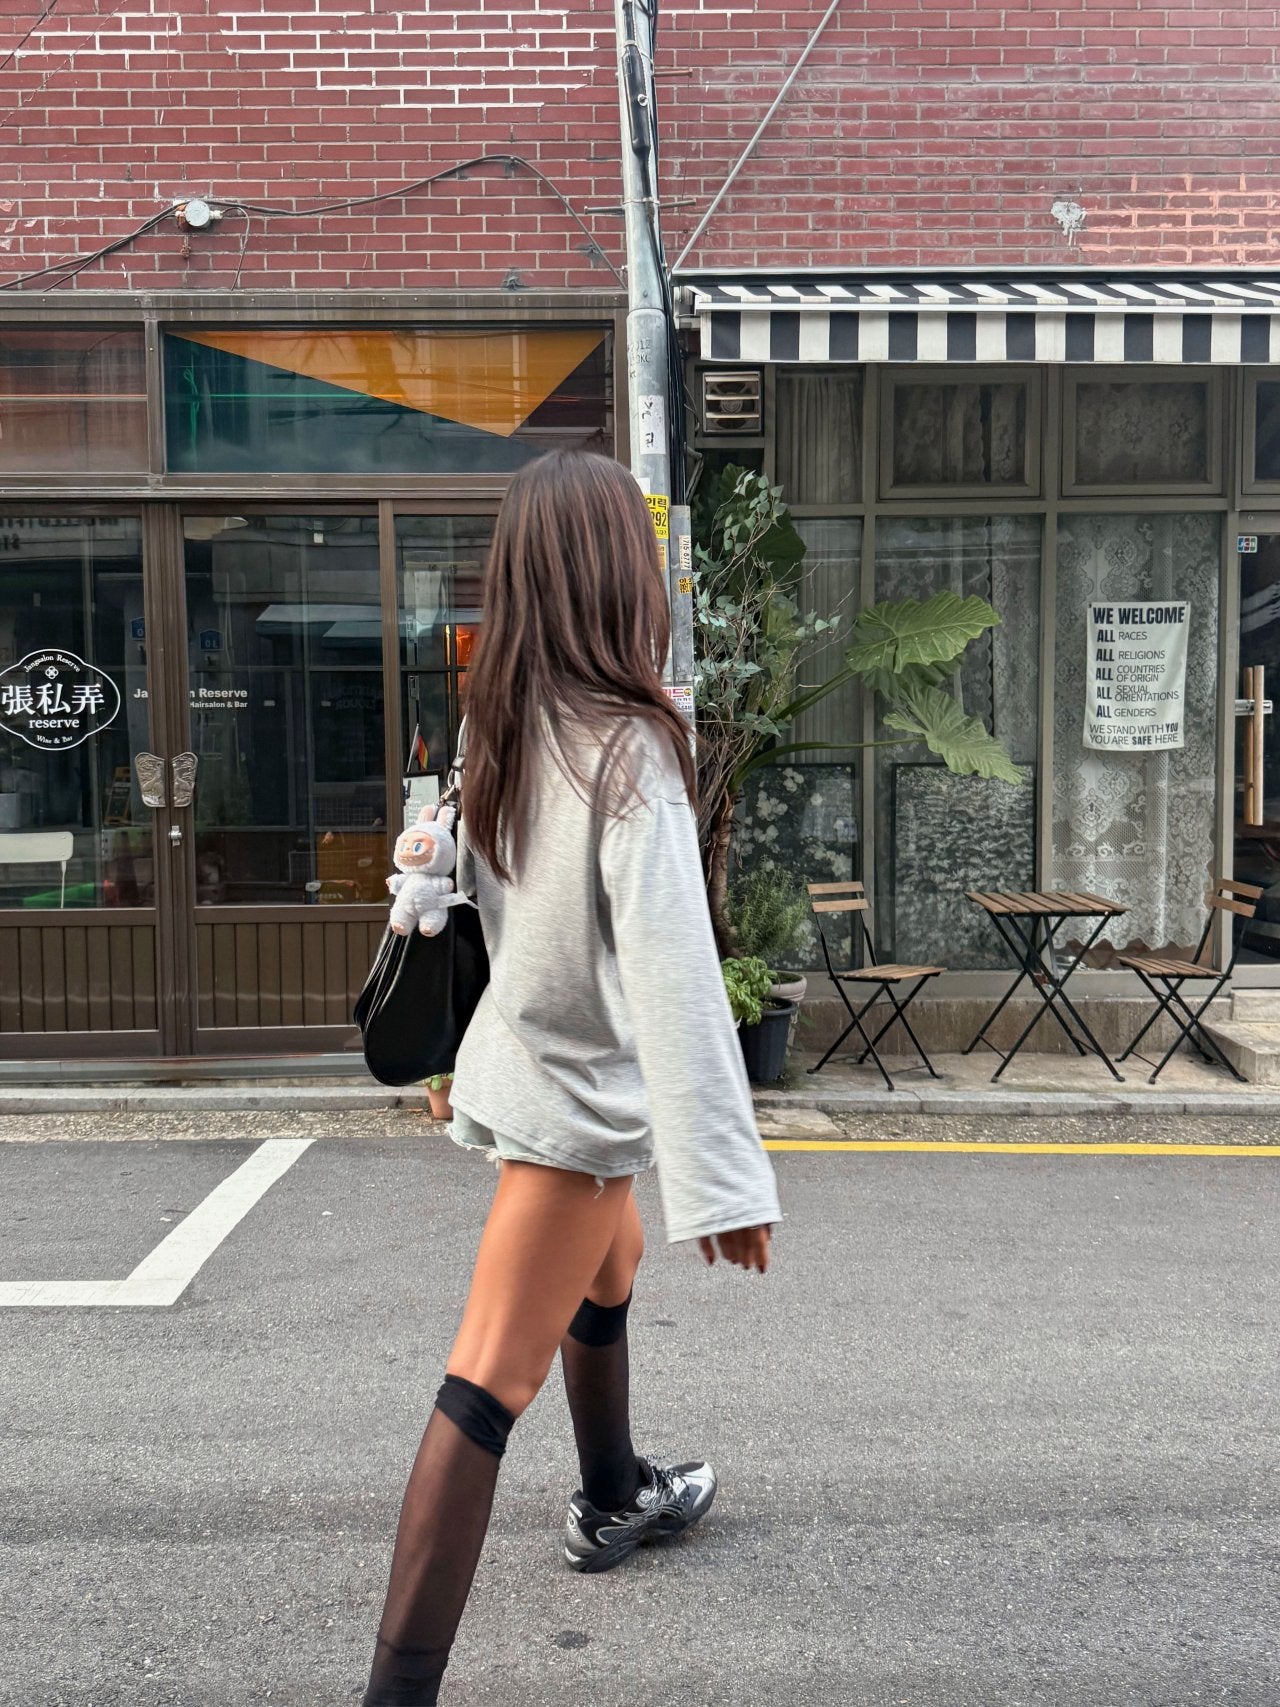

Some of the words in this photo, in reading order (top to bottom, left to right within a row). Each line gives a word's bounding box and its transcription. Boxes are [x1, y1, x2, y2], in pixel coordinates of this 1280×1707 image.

[1093, 607, 1114, 624] WE
[1118, 607, 1185, 624] WELCOME
[1097, 629, 1115, 643] ALL
[1118, 631, 1148, 641] RACES
[1096, 648, 1115, 662] ALL
[1118, 650, 1166, 660] RELIGIONS
[57, 654, 81, 673] Reserve
[1095, 667, 1113, 681] ALL
[1117, 665, 1165, 674] COUNTRIES
[1116, 674, 1129, 683] OF
[1130, 673, 1159, 683] ORIGIN
[199, 688, 248, 698] Reserve
[1096, 686, 1112, 700] ALL
[1116, 685, 1150, 694] SEXUAL
[1115, 691, 1179, 702] ORIENTATIONS
[1, 683, 105, 716] 張私弄
[1096, 705, 1112, 718] ALL
[1114, 707, 1157, 718] GENDERS
[28, 719, 80, 729] reserve
[1089, 724, 1105, 734] WE
[1106, 724, 1137, 735] STAND
[1138, 724, 1164, 735] WITH
[1165, 722, 1179, 733] YOU
[1089, 734, 1111, 744] YOU
[1111, 735, 1129, 745] ARE
[1132, 735, 1152, 745] SAFE
[1155, 733, 1179, 744] HERE
